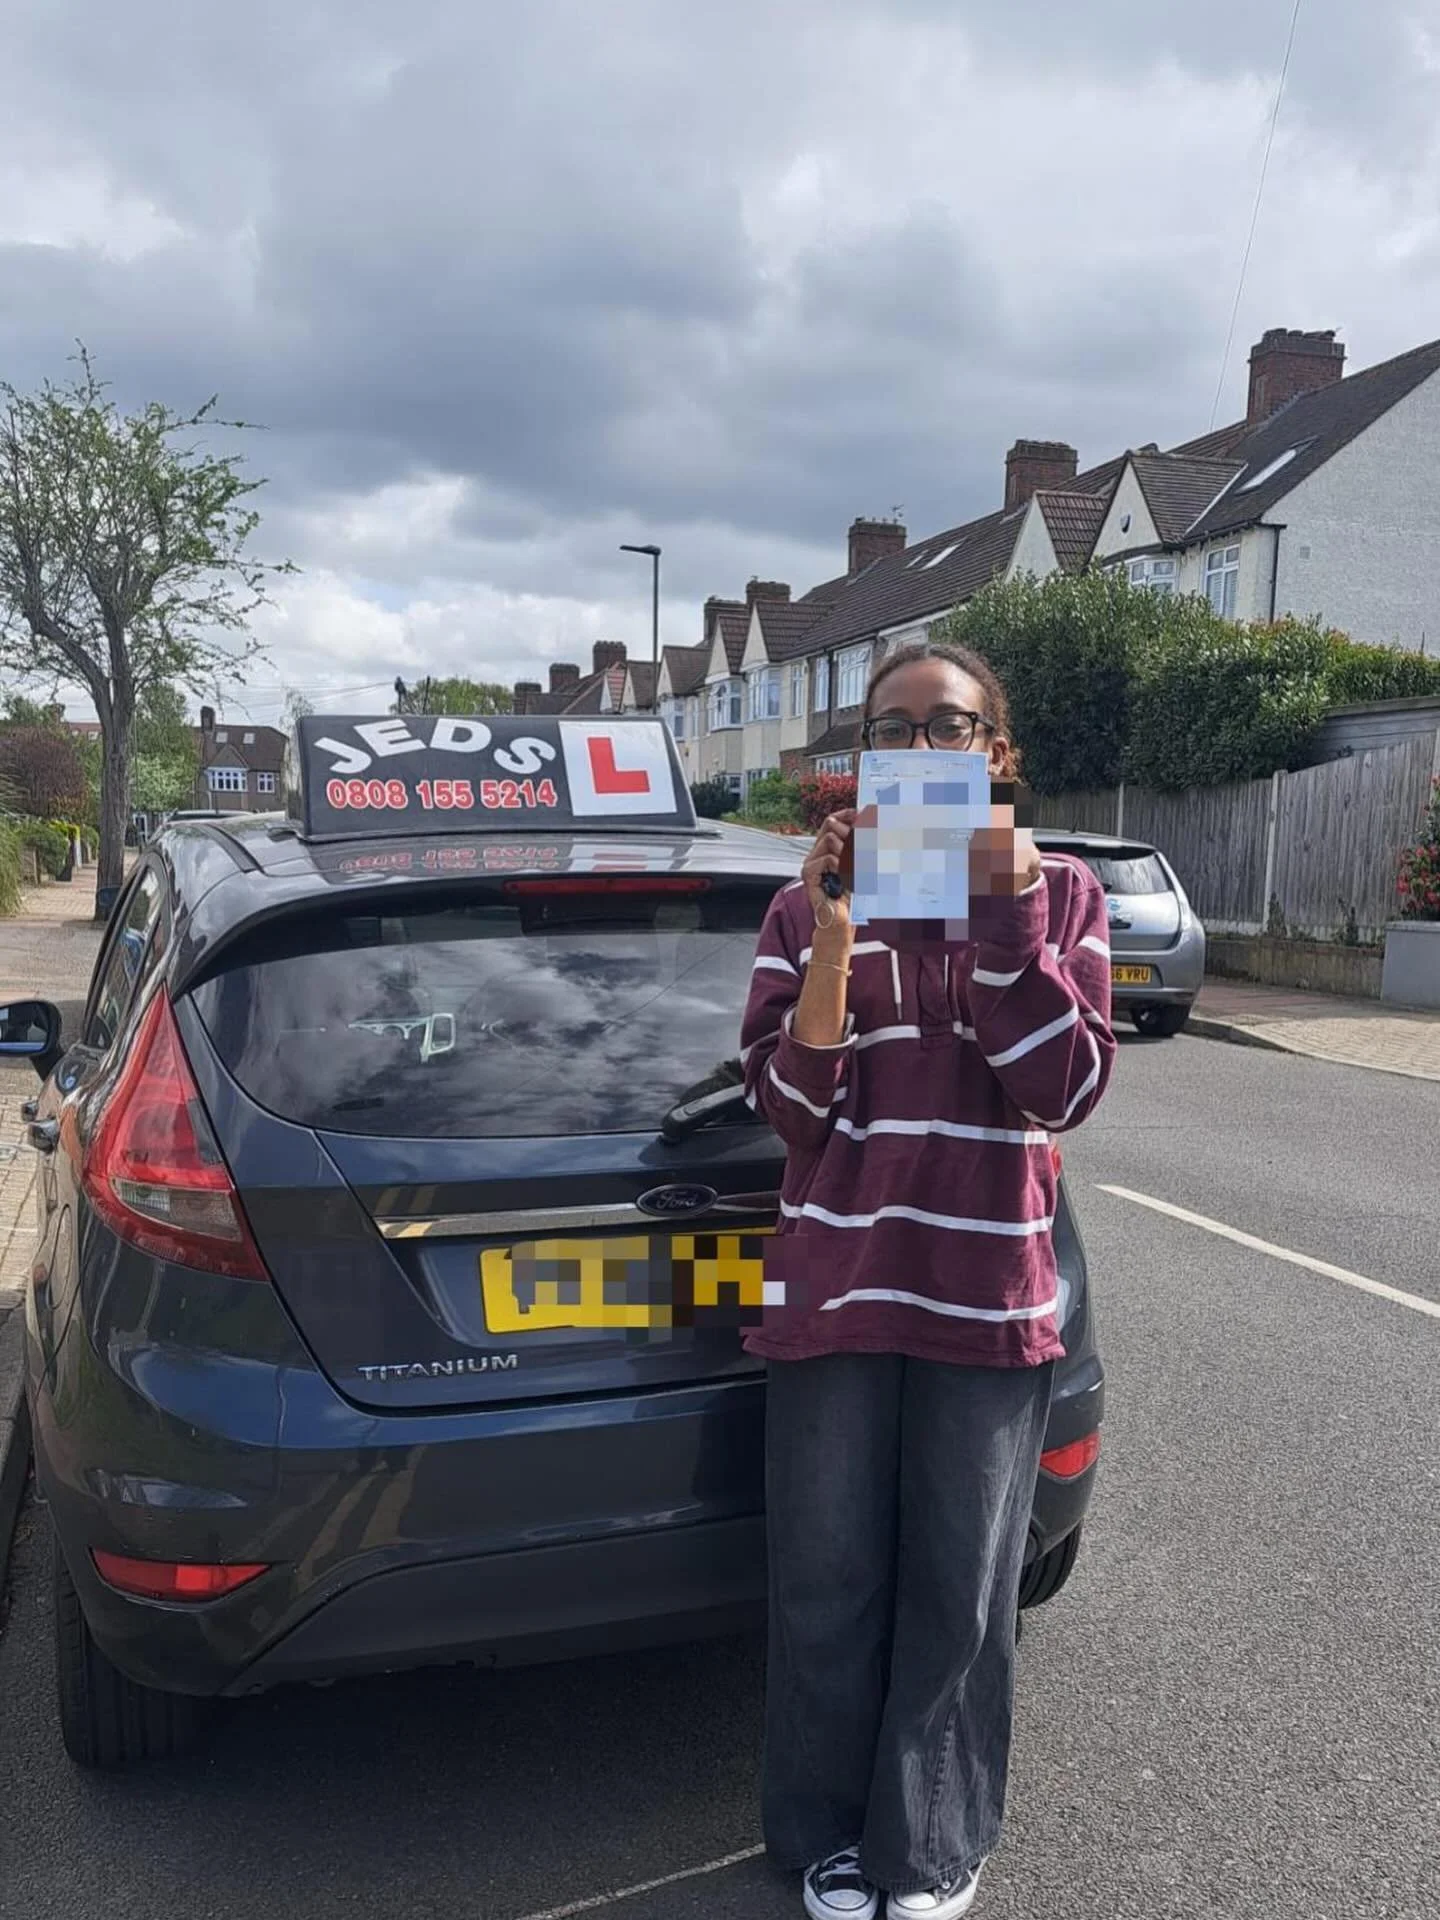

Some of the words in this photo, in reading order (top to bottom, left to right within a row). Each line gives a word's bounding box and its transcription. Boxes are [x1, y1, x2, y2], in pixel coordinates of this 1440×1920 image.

[314, 718, 556, 775] JEDS
[587, 736, 651, 794] L
[326, 779, 407, 810] 0808
[416, 779, 474, 810] 155
[481, 778, 558, 809] 5214
[1126, 967, 1149, 981] VRU
[656, 1190, 699, 1210] Ford
[358, 1354, 518, 1381] TITANIUM
